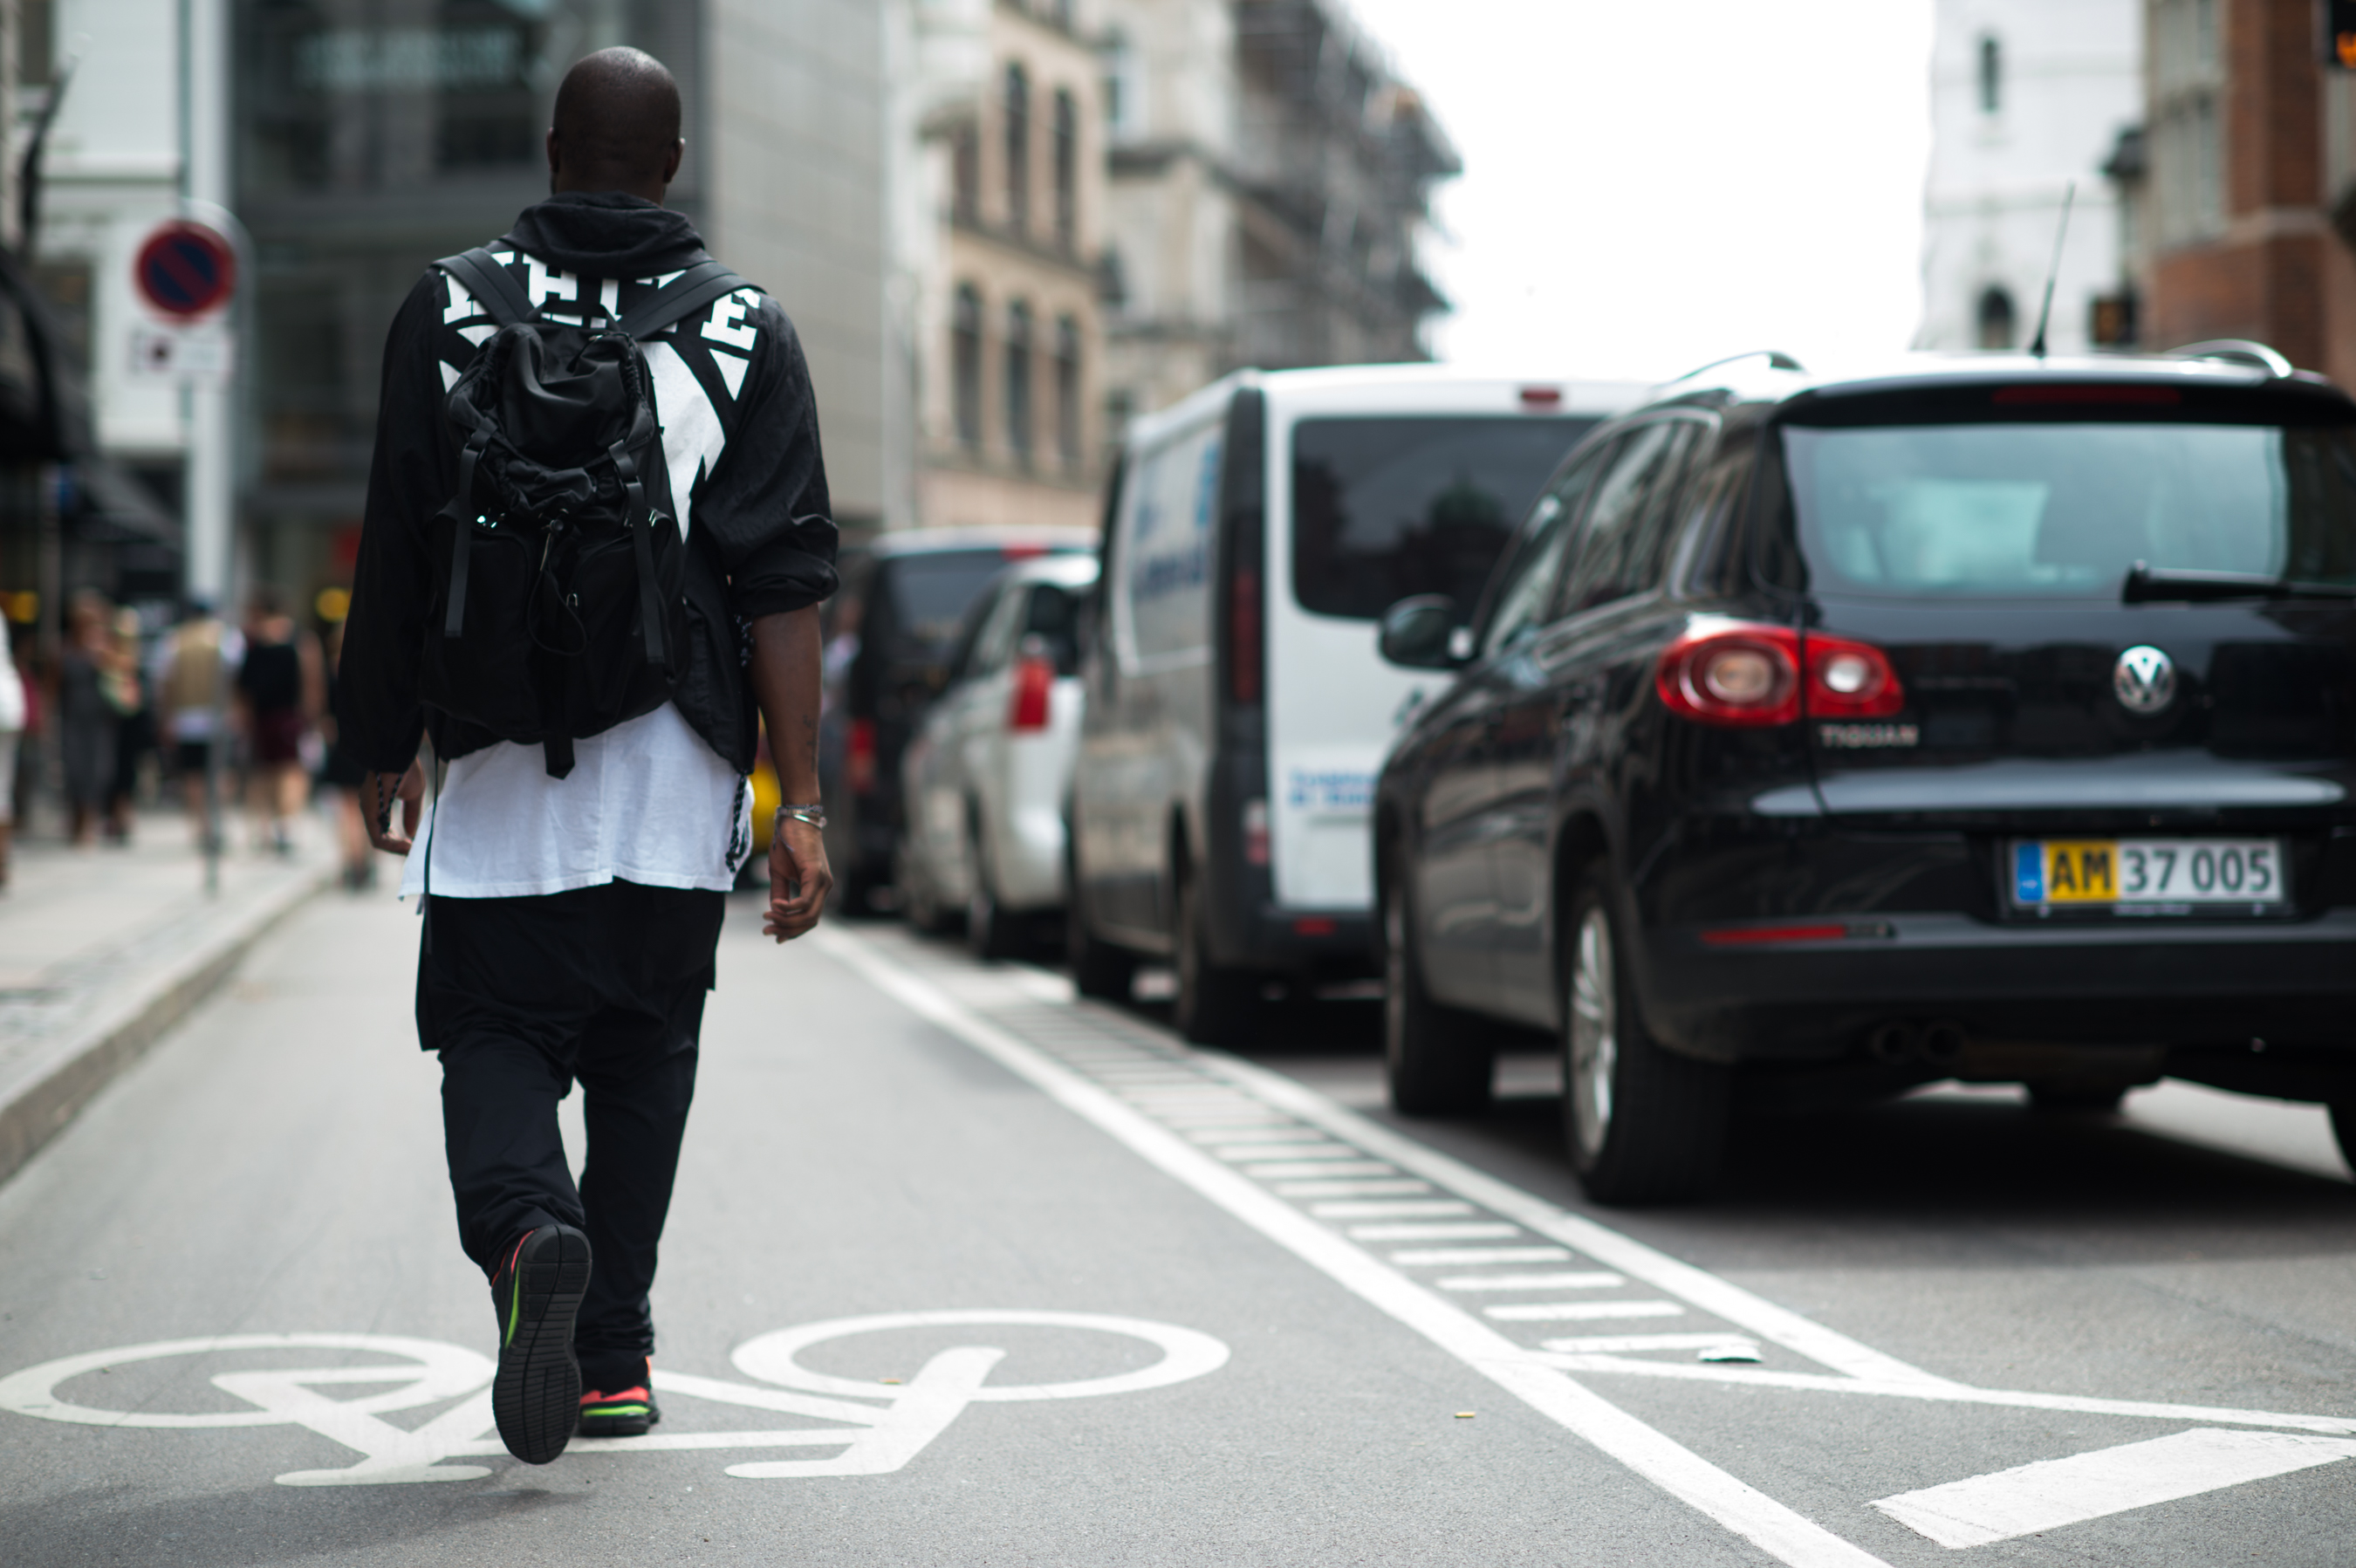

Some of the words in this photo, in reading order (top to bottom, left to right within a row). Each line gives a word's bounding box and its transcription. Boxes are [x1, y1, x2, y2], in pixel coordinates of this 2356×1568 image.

[439, 250, 761, 351] HIE
[2049, 849, 2113, 892] AM
[2122, 849, 2178, 893] 37
[2190, 848, 2272, 893] 005
